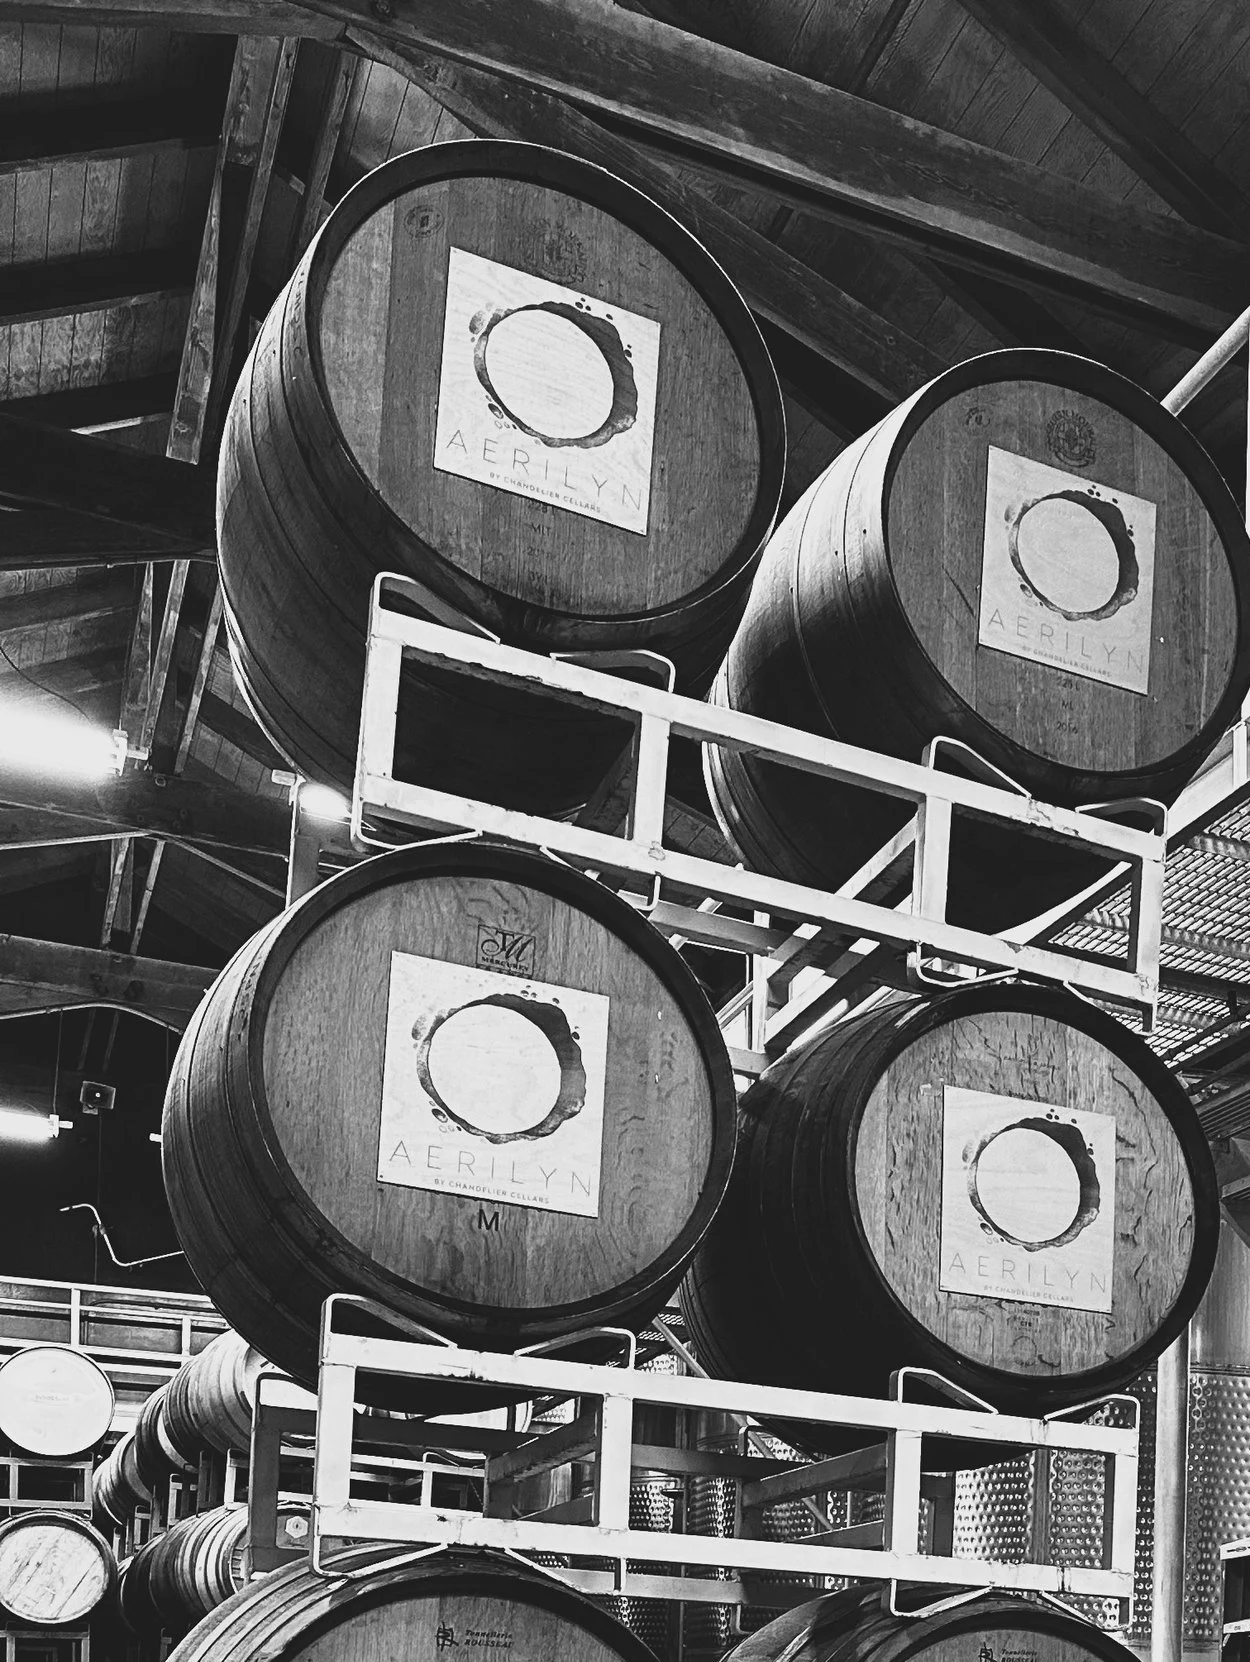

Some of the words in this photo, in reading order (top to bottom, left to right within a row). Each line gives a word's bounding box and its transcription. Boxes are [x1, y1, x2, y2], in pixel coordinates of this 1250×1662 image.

[447, 429, 642, 511] AERILYN
[503, 476, 560, 500] CHANDELIER
[563, 495, 601, 513] CELLARS
[988, 608, 1144, 674] AERILYN
[389, 1140, 591, 1197] AERILYN
[434, 1178, 445, 1186] BY
[448, 1180, 507, 1197] CHANDELIER
[510, 1191, 550, 1204] CELLARS
[477, 1208, 500, 1232] M
[949, 1252, 1106, 1293] AERILYN
